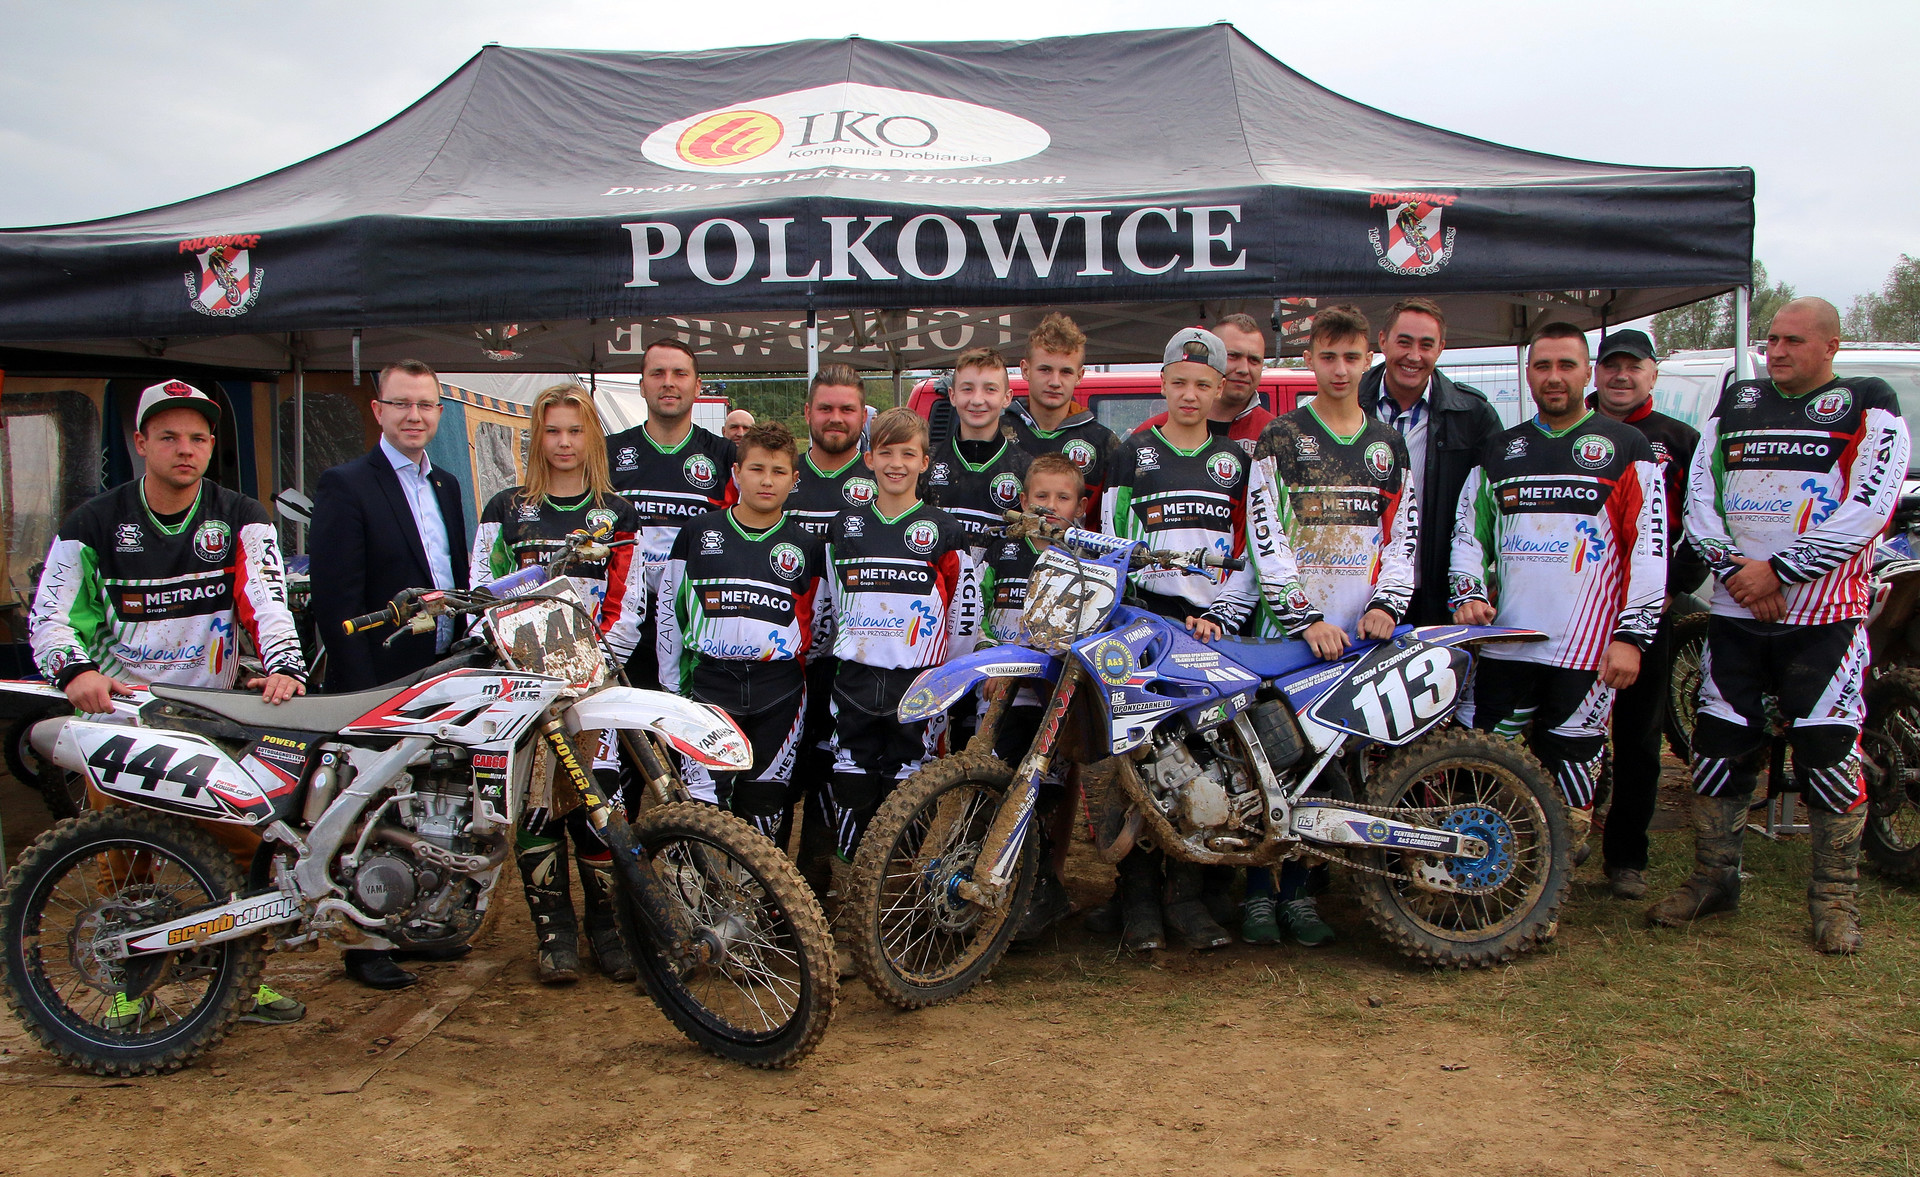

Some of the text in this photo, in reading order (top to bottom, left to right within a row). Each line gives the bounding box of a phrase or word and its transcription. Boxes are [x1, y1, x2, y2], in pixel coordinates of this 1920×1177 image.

[793, 110, 938, 148] IKO
[788, 146, 992, 163] Kompania Drobiarska
[601, 167, 1067, 198] Drób z Polskich Hodowli
[1369, 192, 1458, 208] POLKOWICE
[178, 234, 261, 254] POLKOWICE
[622, 204, 1248, 288] POLKOWICE
[1808, 408, 1846, 423] POLKOWICE
[1744, 442, 1829, 457] METRACO
[1853, 427, 1898, 507] KGHM
[1876, 436, 1907, 517] FUNDACJA
[1519, 487, 1598, 501] METRACO
[1163, 502, 1231, 519] METRACO
[1322, 499, 1379, 512] METRAC
[1250, 487, 1276, 557] KGHM
[1651, 478, 1663, 558] KGHM
[1745, 514, 1791, 524] PRZYSZŁOŚĆ
[1069, 529, 1131, 546] RENTHAL
[1526, 554, 1568, 563] PRZYSZŁOŚĆ
[860, 568, 928, 583] METRACO
[146, 582, 226, 605] METRACO
[511, 578, 540, 597] YAMAHA
[721, 591, 791, 612] METRACO
[958, 568, 976, 636] KGHM
[659, 580, 674, 655] ZANAM
[844, 611, 905, 628] Polkowice
[1124, 625, 1154, 644] YAMAHA
[1107, 657, 1123, 667] A&S
[1111, 691, 1125, 702] 113
[1352, 646, 1457, 740] 113
[1113, 700, 1172, 714] OPONYCZARNE.EU
[1233, 697, 1247, 709] 113
[1198, 703, 1228, 725] MGX
[262, 735, 307, 750] POWER 4
[696, 727, 736, 751] YAMAHA
[88, 735, 220, 799] 444
[473, 754, 508, 769] CARGO
[549, 732, 601, 808] POWER 4
[481, 785, 503, 795] MGX
[1299, 817, 1313, 827] 113
[1393, 829, 1420, 838] CENTRUM
